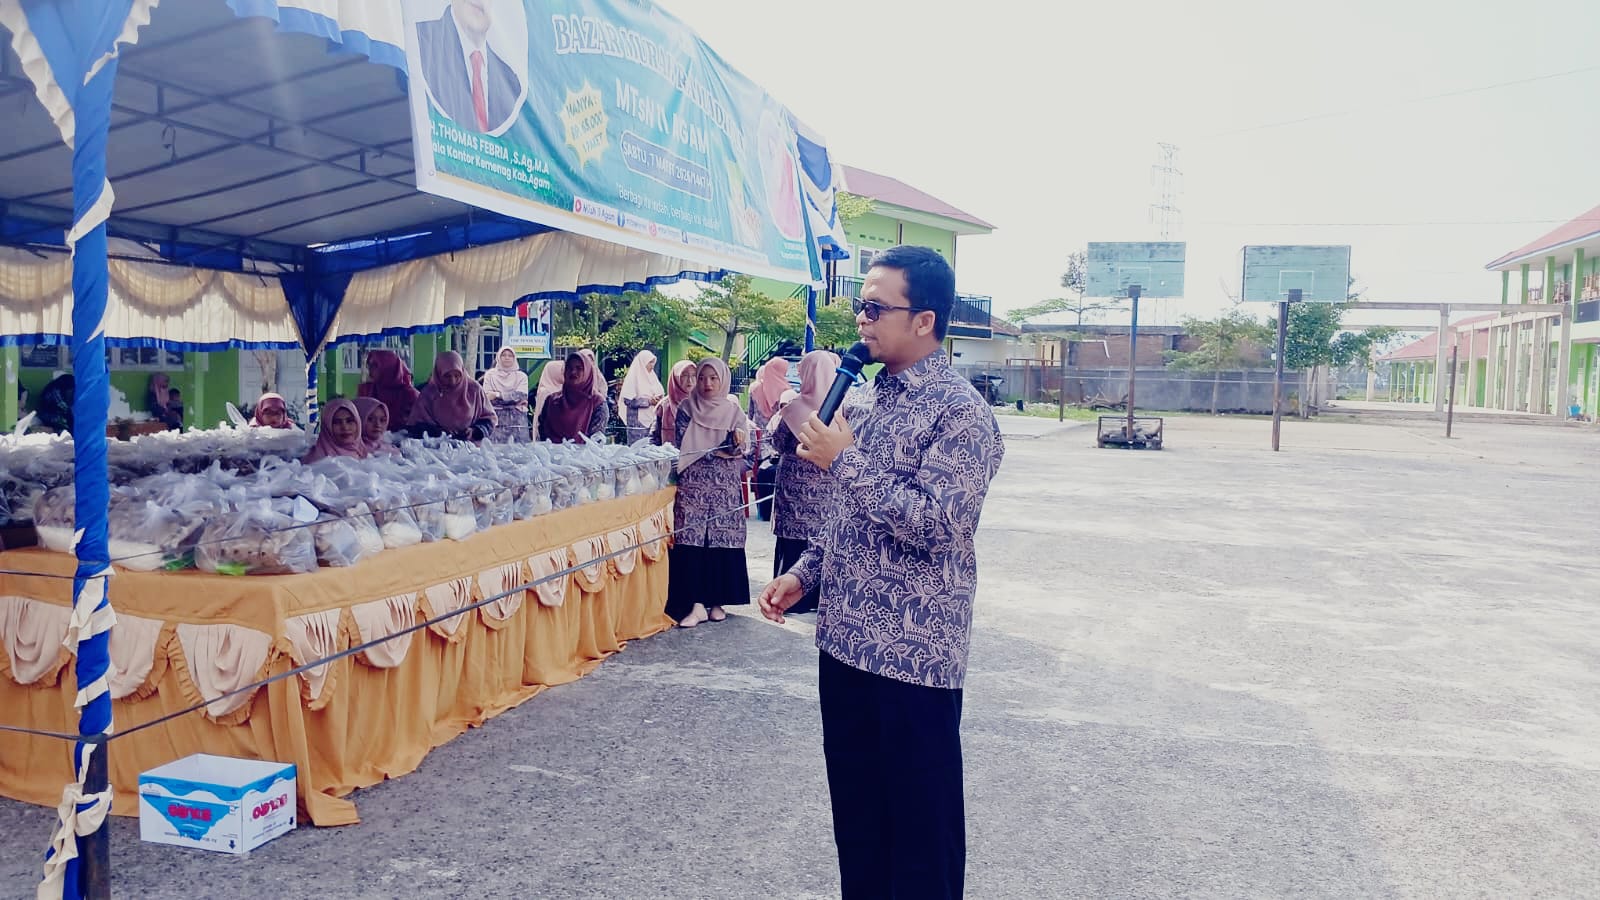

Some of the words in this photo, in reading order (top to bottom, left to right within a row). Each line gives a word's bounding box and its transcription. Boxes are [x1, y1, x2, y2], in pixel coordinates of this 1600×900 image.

[551, 14, 624, 58] BAZAR
[446, 145, 475, 166] Kantor
[475, 155, 512, 181] Kemenag
[480, 140, 509, 162] FEBRIA
